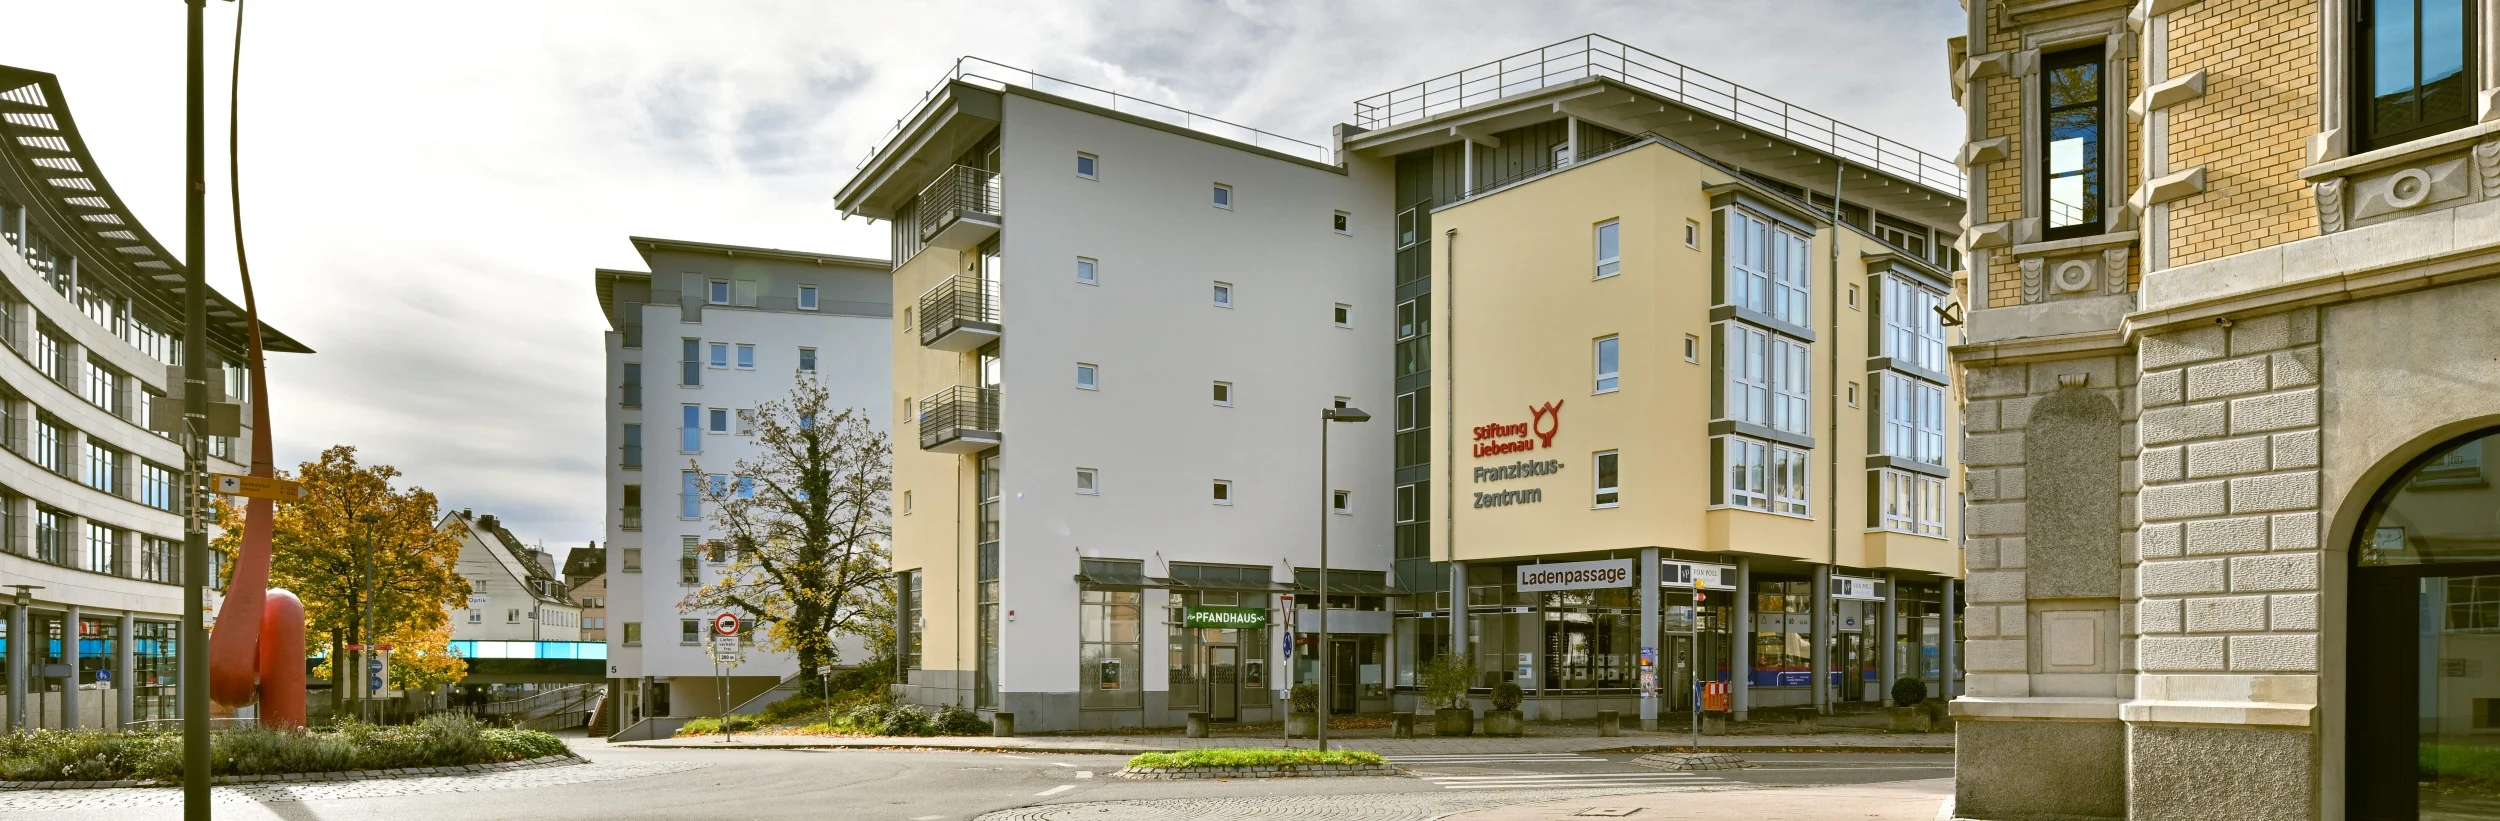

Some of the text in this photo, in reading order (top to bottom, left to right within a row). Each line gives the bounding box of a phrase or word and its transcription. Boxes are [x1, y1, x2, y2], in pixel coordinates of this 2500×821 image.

[1473, 422, 1528, 441] Stiftung
[1473, 439, 1534, 458] Liebenau
[1473, 459, 1565, 483] Franziskus-
[1473, 488, 1542, 509] Zentrum
[1522, 567, 1626, 585] Ladenpassage
[1196, 612, 1257, 624] PFANDHAUS
